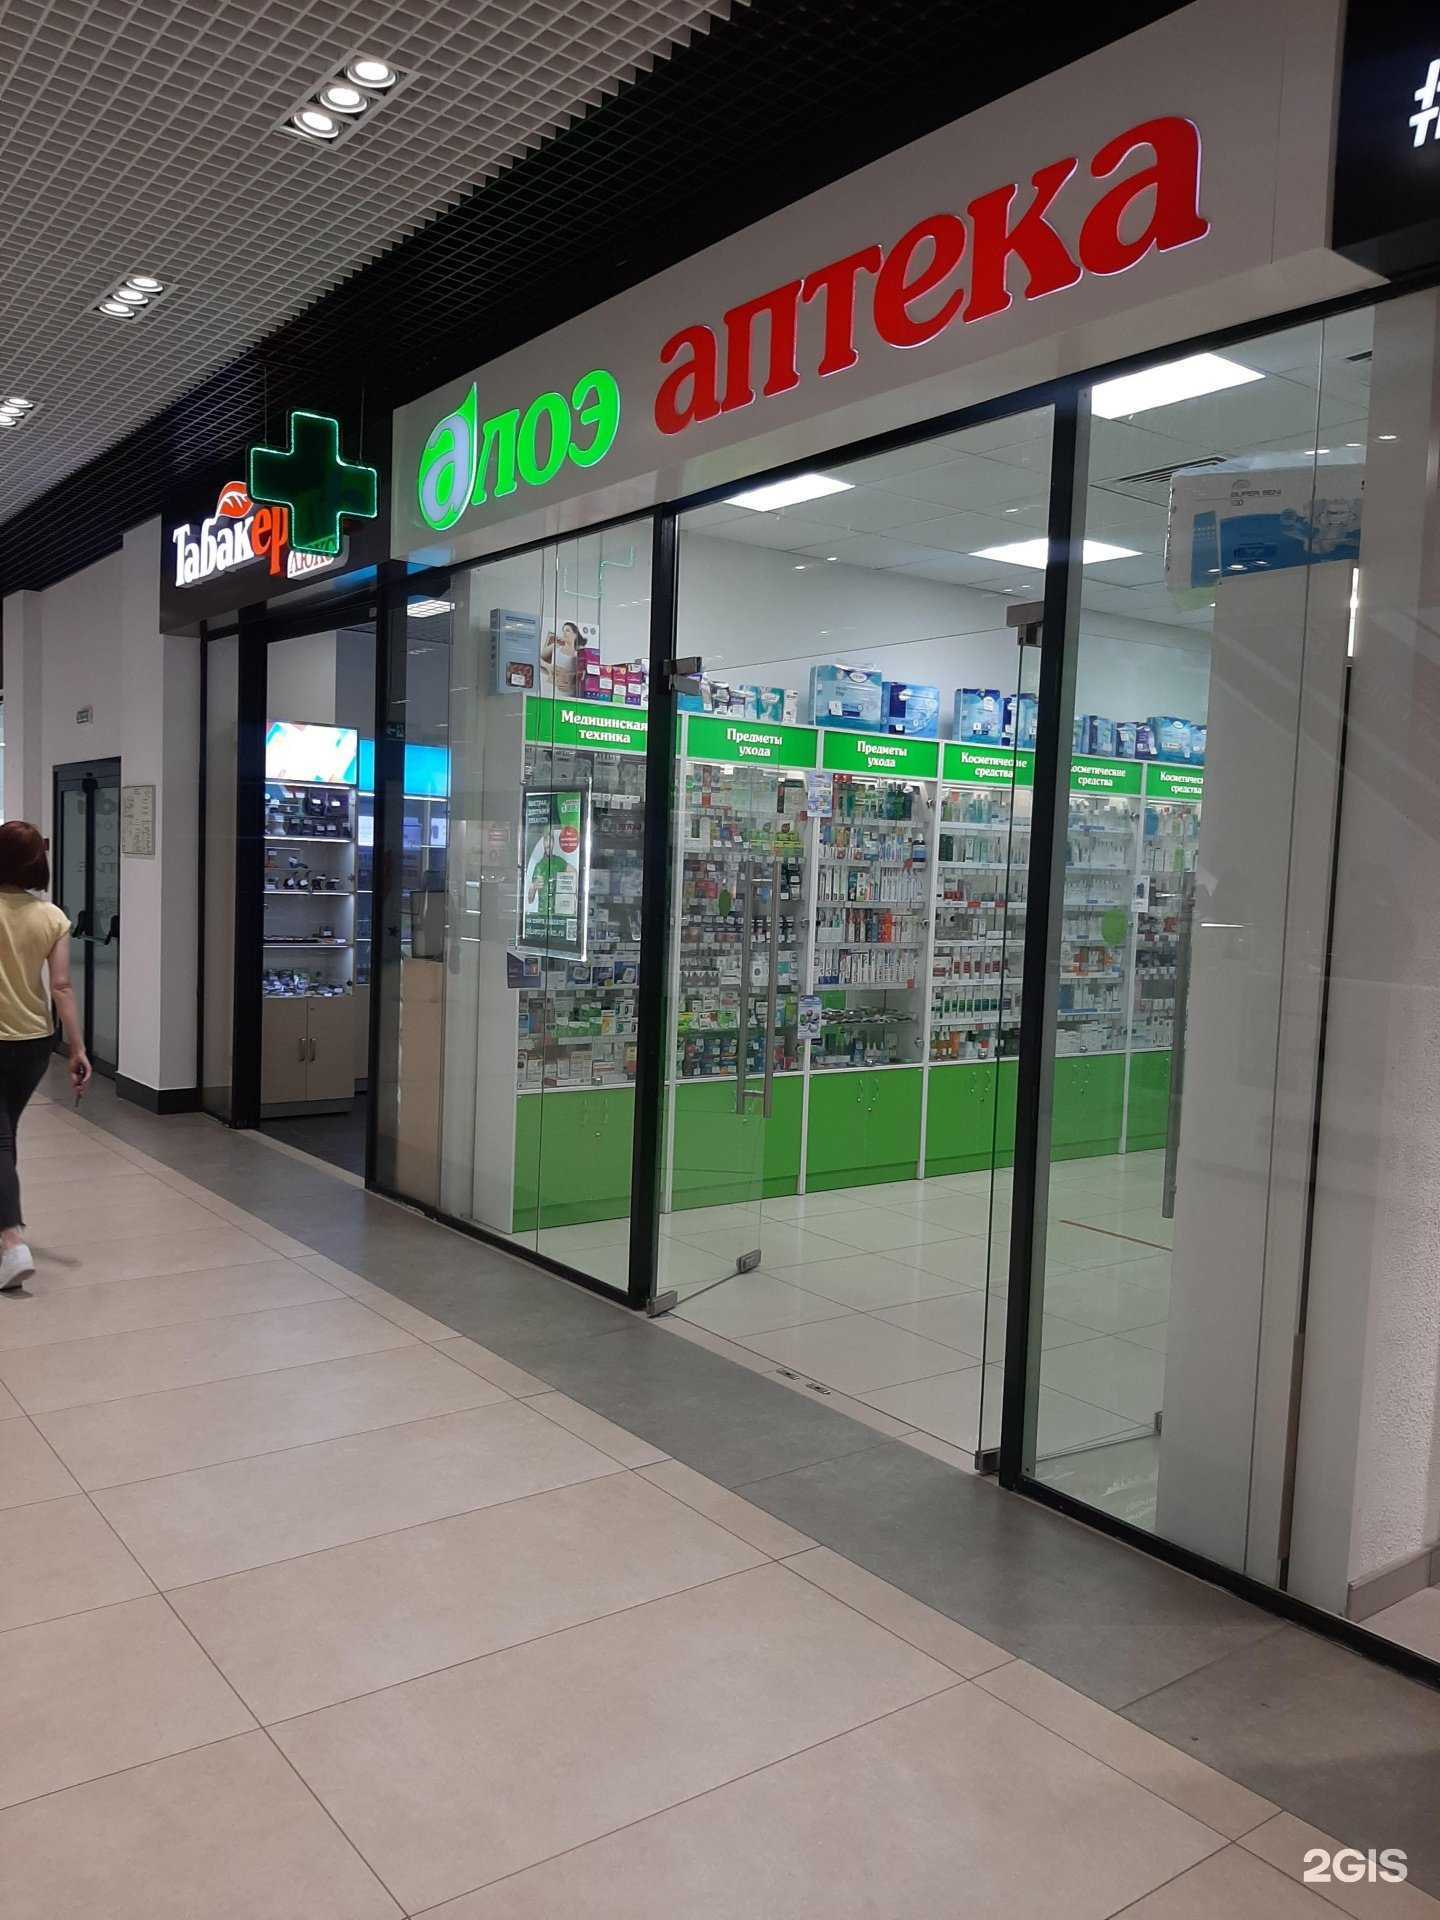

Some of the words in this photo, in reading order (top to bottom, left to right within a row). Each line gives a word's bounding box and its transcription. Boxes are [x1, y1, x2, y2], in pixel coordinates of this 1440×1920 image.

[654, 116, 1211, 436] аптека
[561, 709, 648, 731] Медицинская
[578, 729, 631, 744] техника
[727, 728, 782, 745] Предметы
[739, 746, 771, 757] ухода
[857, 741, 907, 757] Предметы
[867, 757, 896, 768] ухода
[961, 751, 1028, 768] Косметичесие
[975, 767, 1014, 778] средства
[1071, 765, 1126, 777] осметические
[1078, 777, 1113, 787] средства
